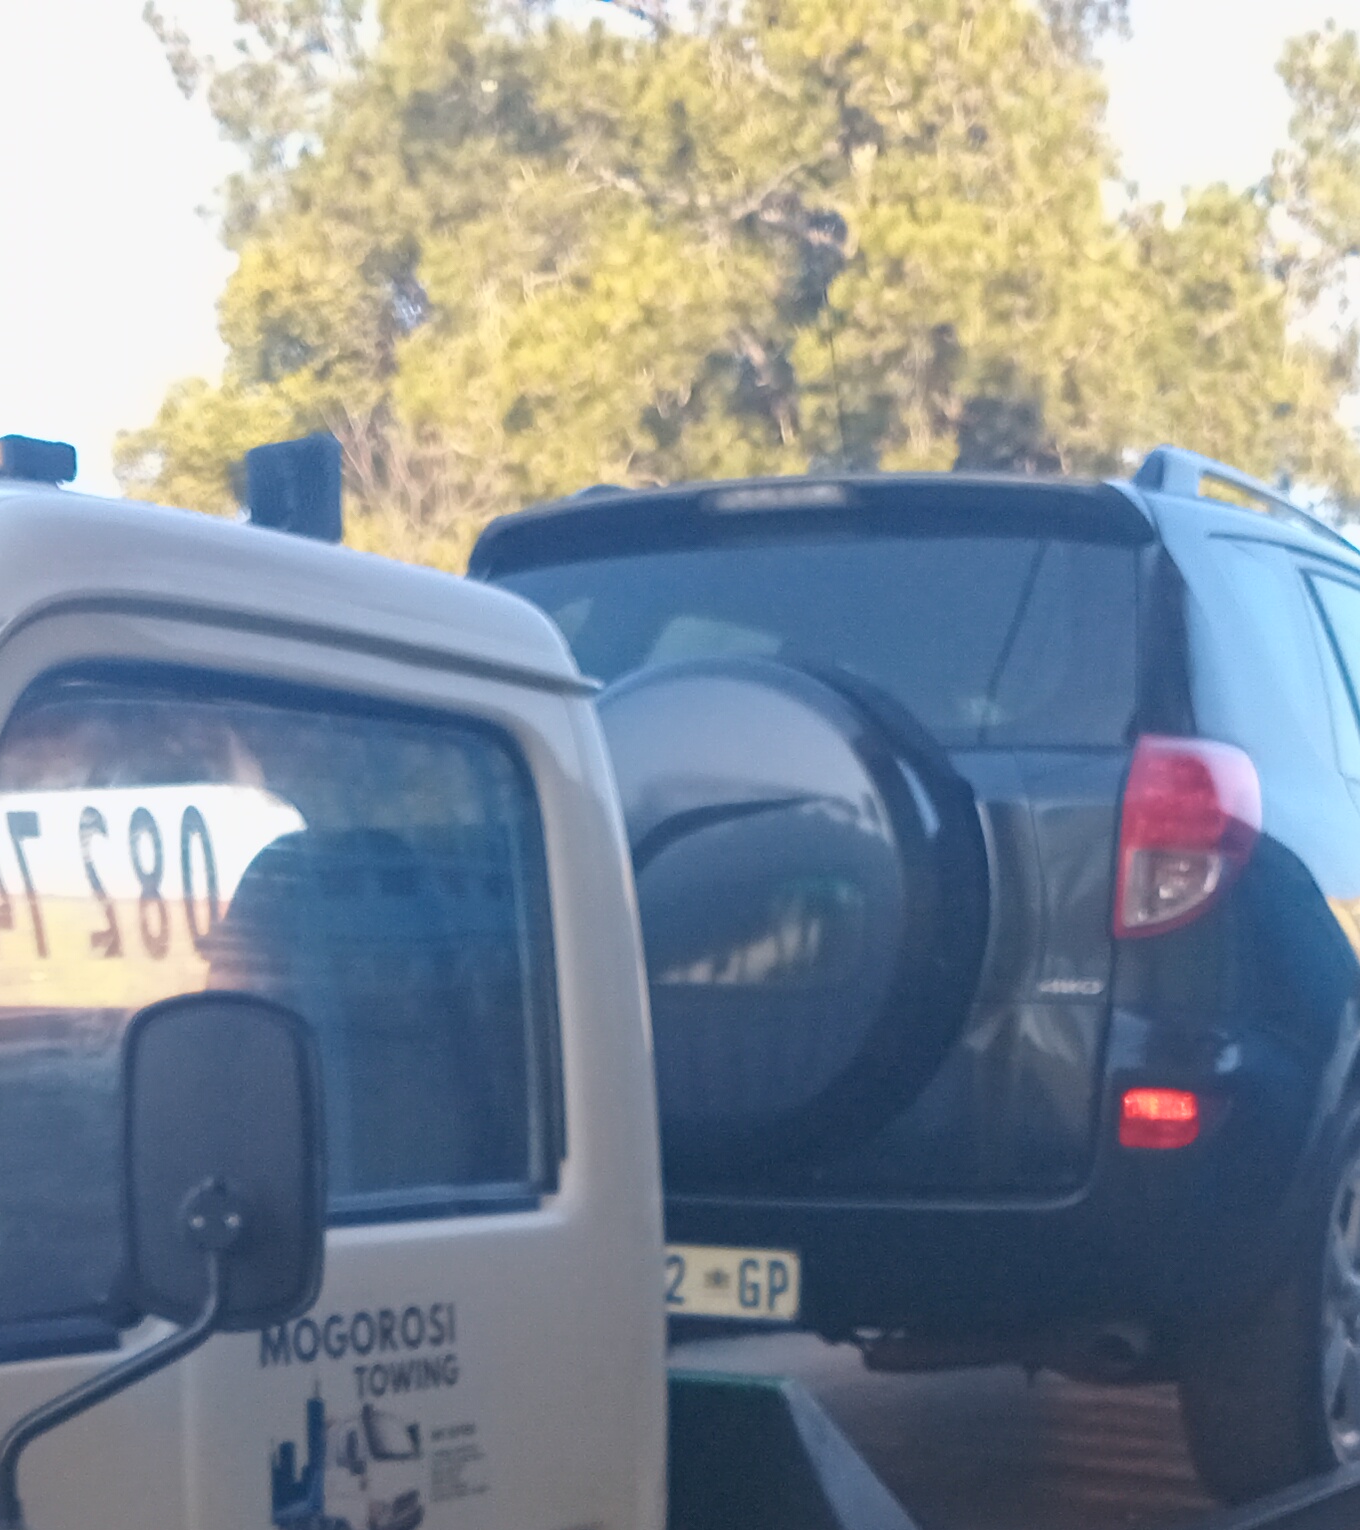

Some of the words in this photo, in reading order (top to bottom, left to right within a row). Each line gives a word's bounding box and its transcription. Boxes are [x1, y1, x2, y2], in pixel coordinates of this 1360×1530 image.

[738, 1258, 789, 1312] GP
[260, 1302, 456, 1368] MOGOROSI
[354, 1353, 460, 1398] TOWING
